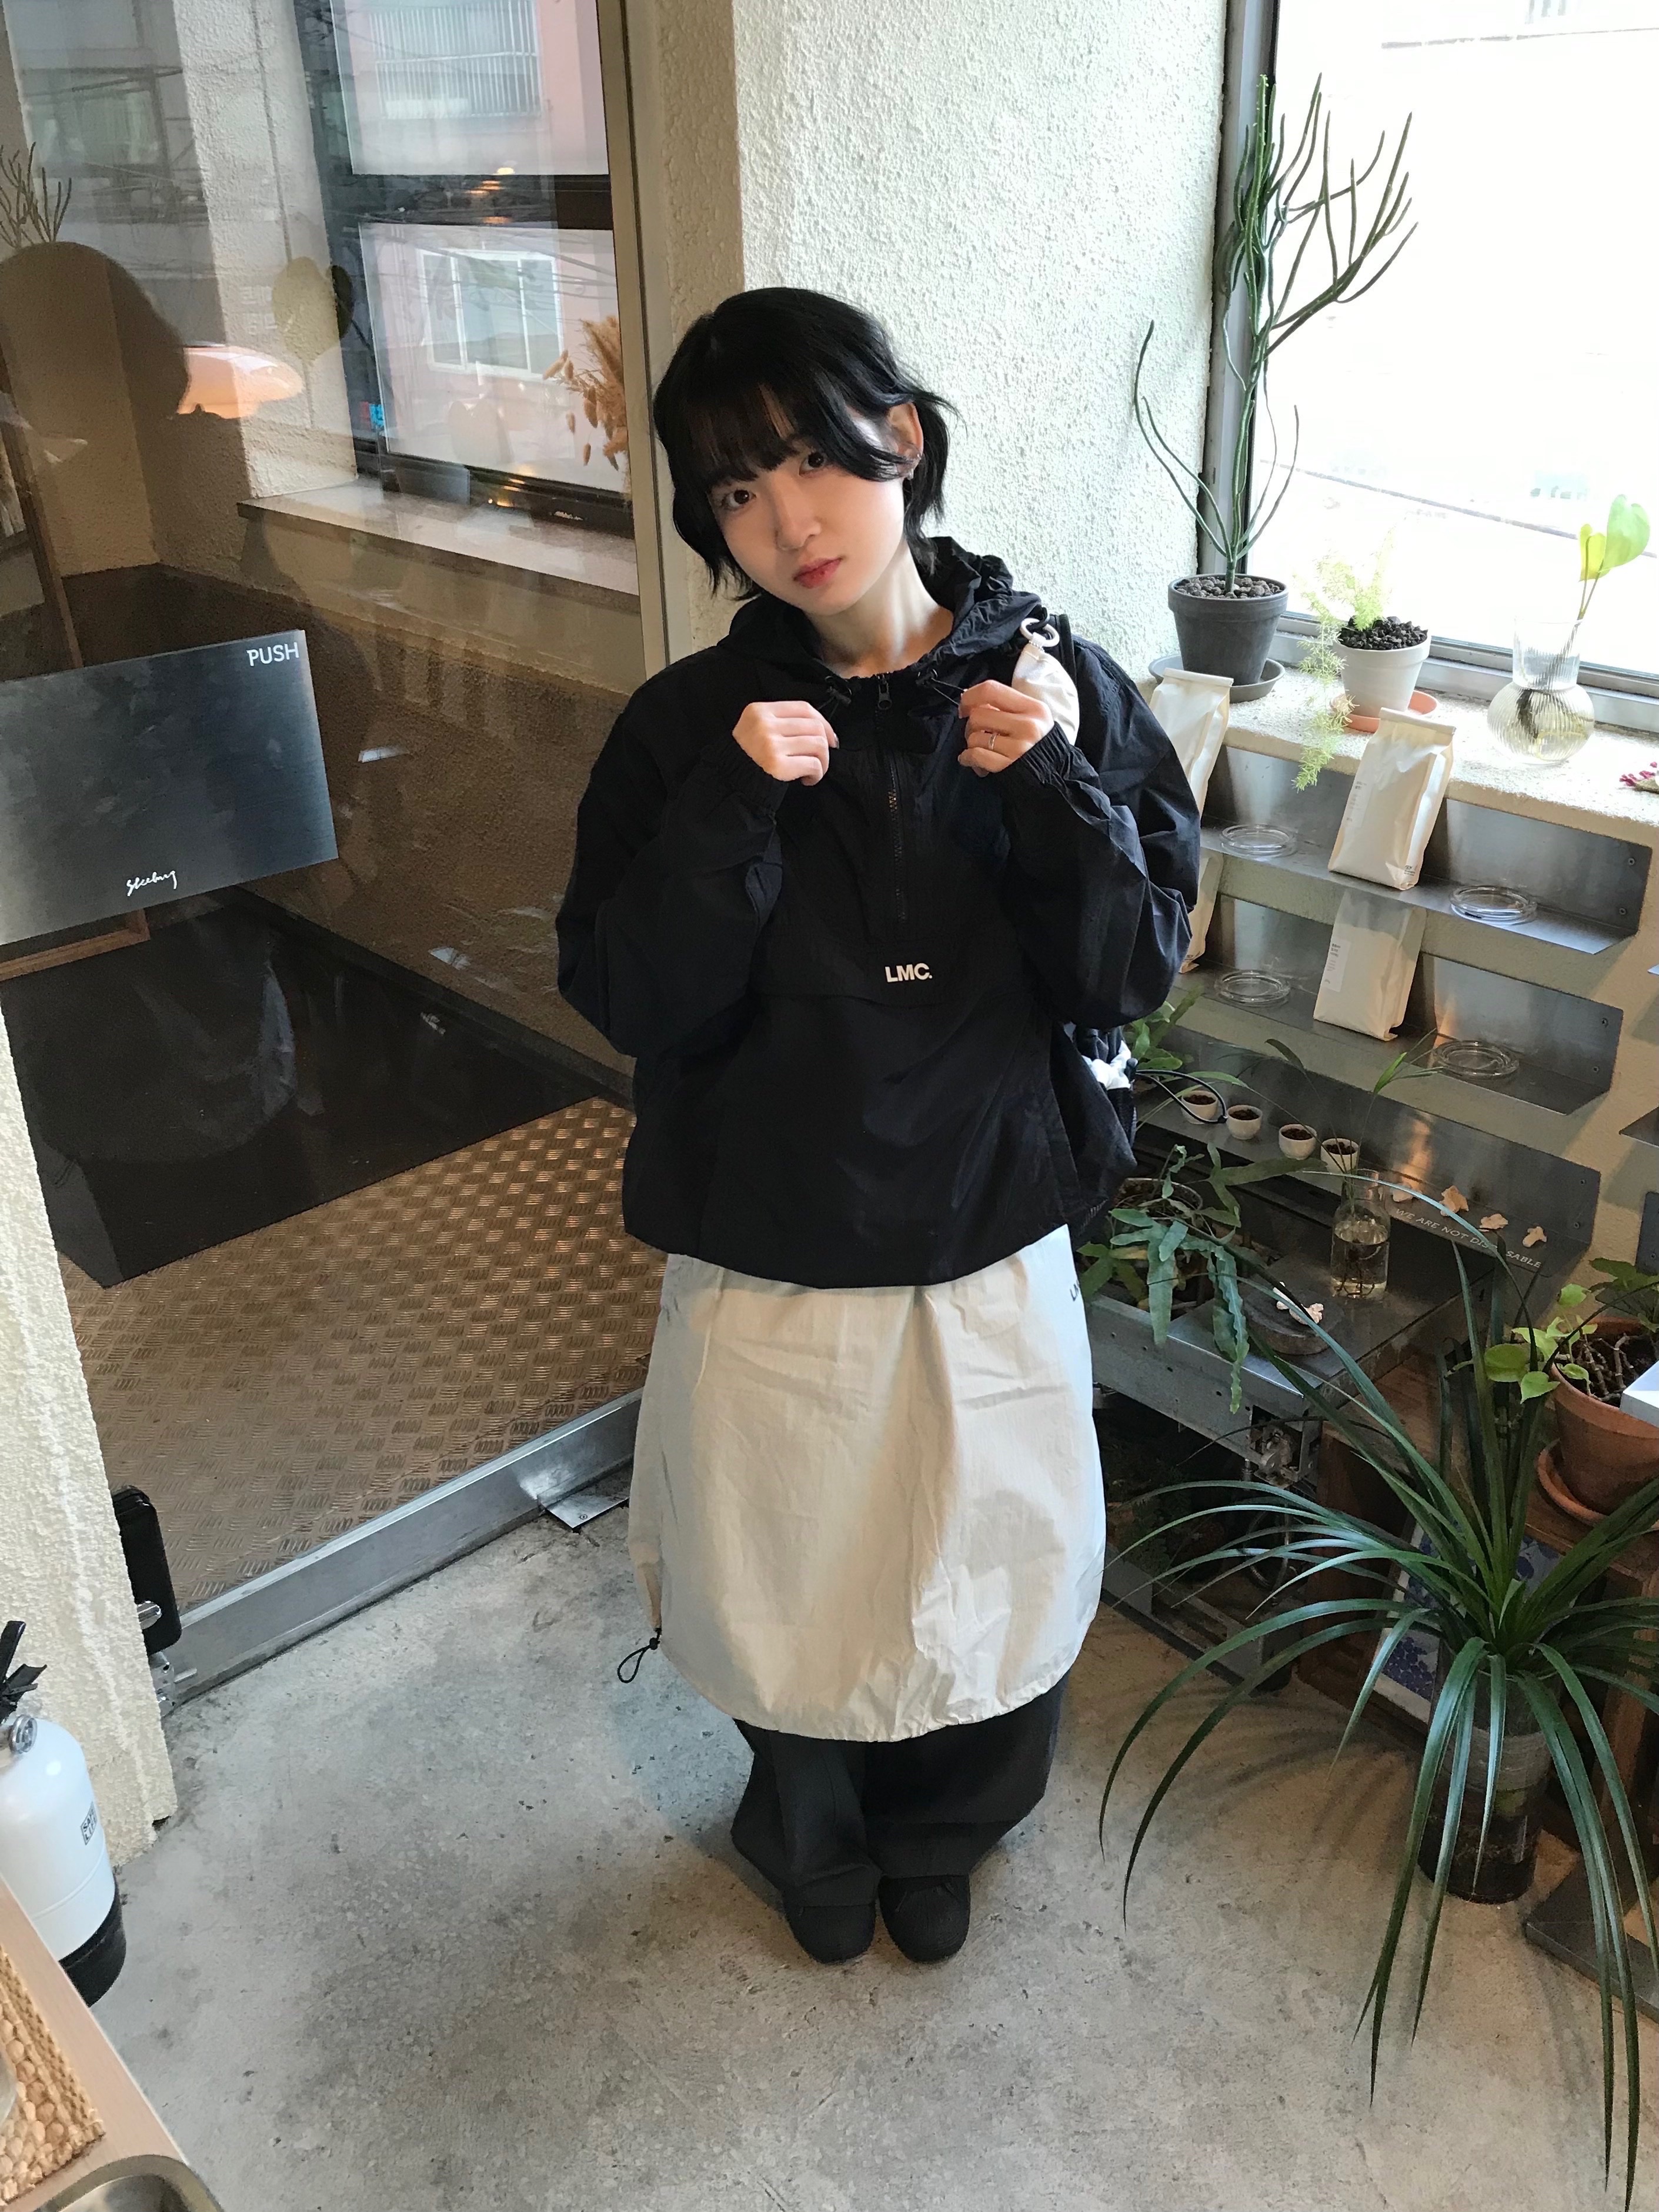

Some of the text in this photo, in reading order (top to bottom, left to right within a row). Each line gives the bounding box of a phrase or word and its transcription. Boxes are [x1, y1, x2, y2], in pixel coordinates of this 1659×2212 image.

[246, 641, 299, 667] PUSH
[884, 963, 933, 983] LMC.
[1396, 1208, 1542, 1268] WE ARE NOT DISSABLE
